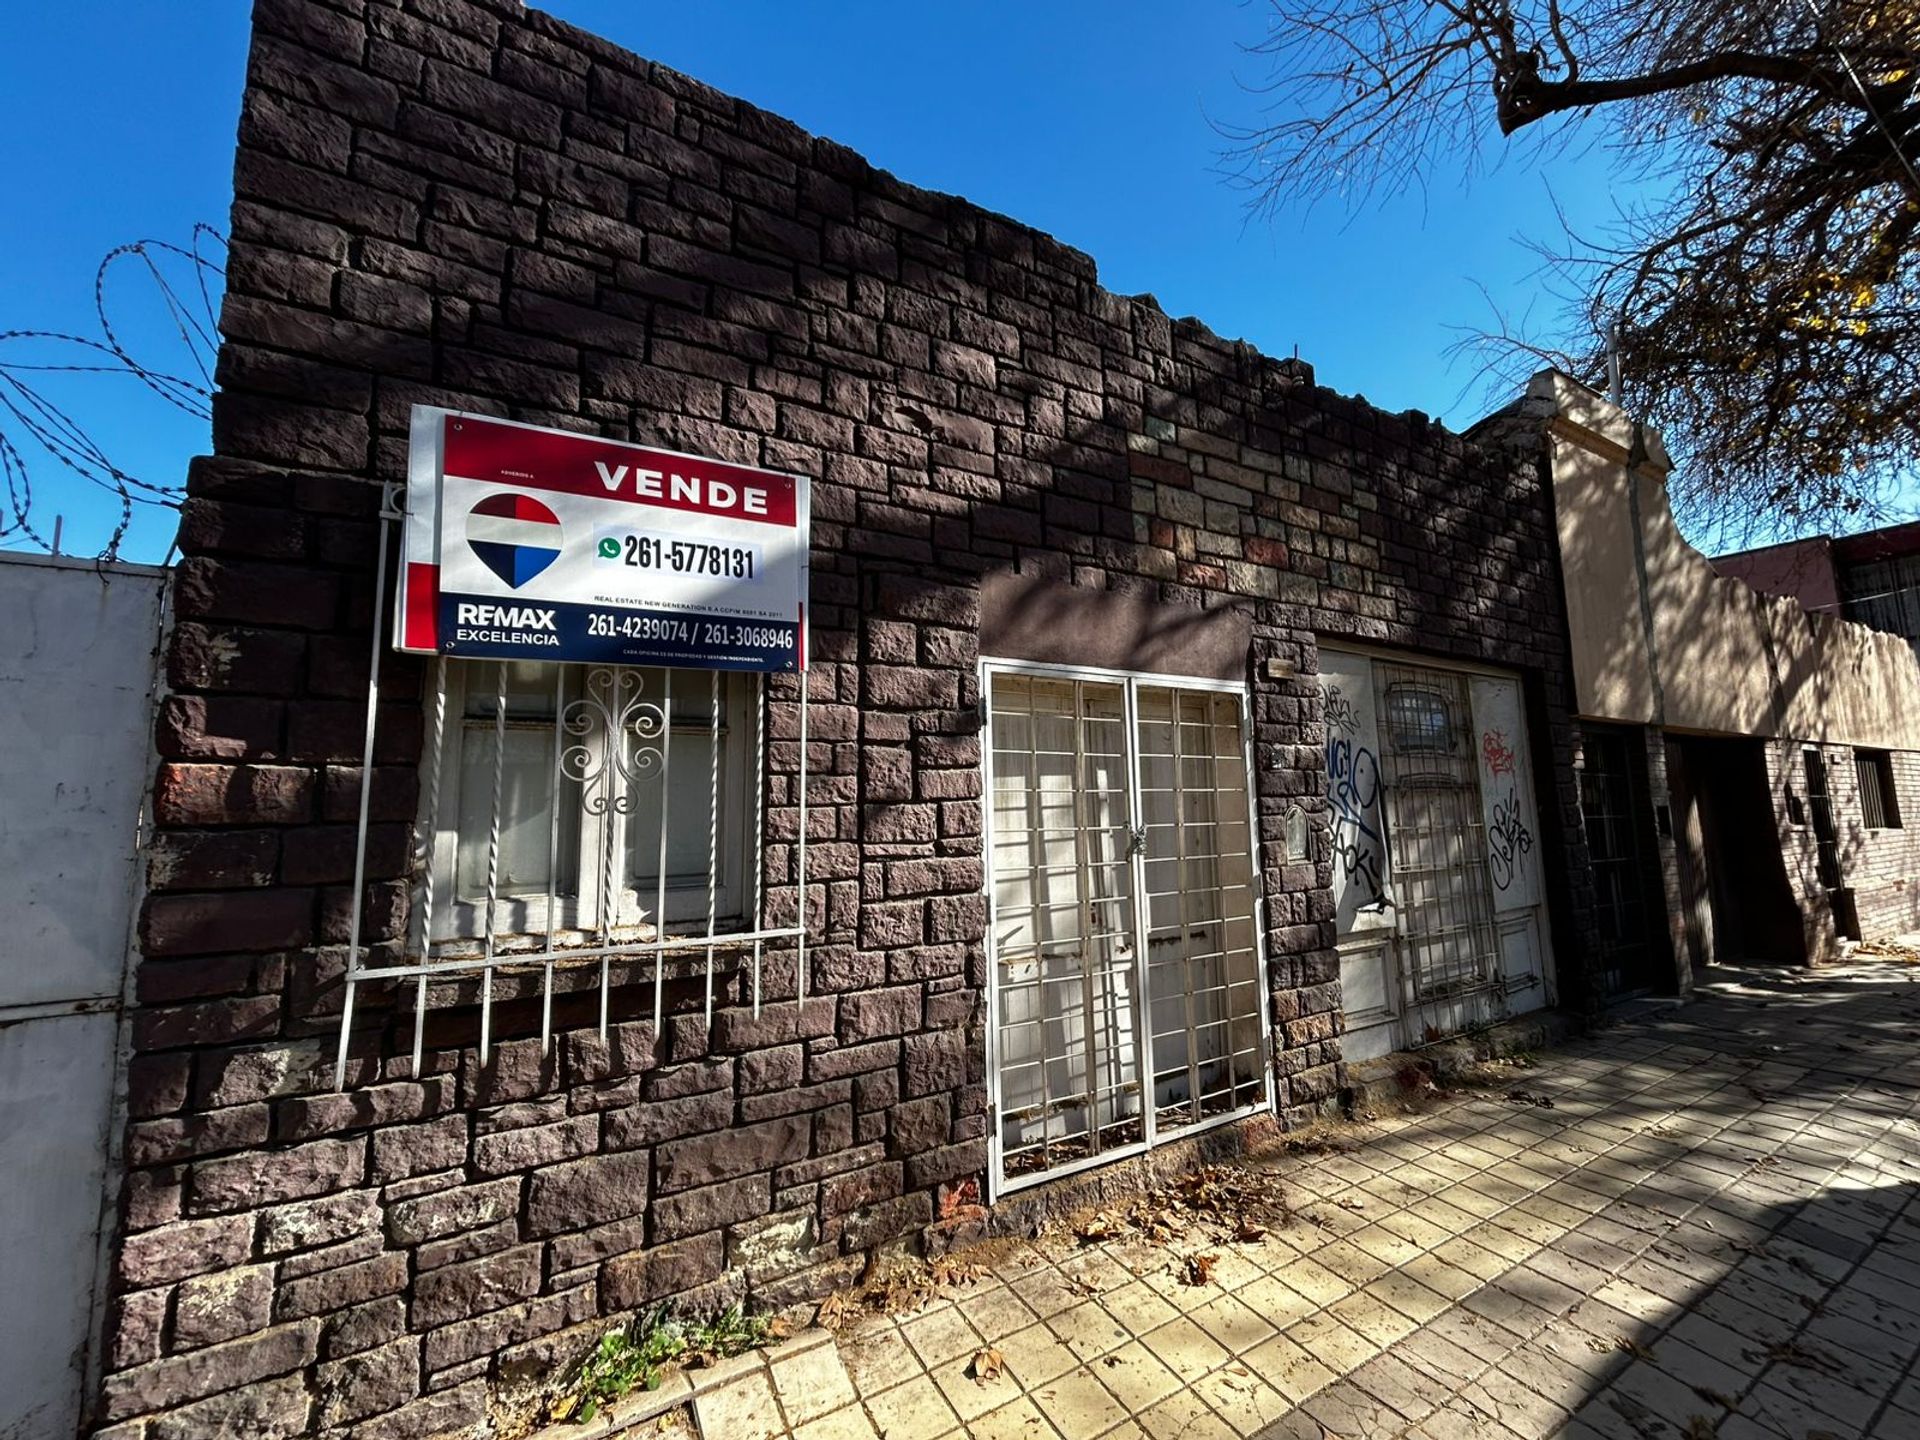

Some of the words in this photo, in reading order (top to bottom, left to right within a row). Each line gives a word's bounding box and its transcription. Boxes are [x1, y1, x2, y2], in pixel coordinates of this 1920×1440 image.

[594, 460, 768, 515] VENDE
[625, 535, 753, 579] 261-5778131
[594, 595, 613, 603] REAL
[616, 597, 643, 606] ESTATE
[662, 601, 706, 611] GENERATION
[457, 629, 560, 646] EXCELENCIA
[588, 613, 688, 642] 261-4239074
[704, 623, 793, 649] 261-3068946
